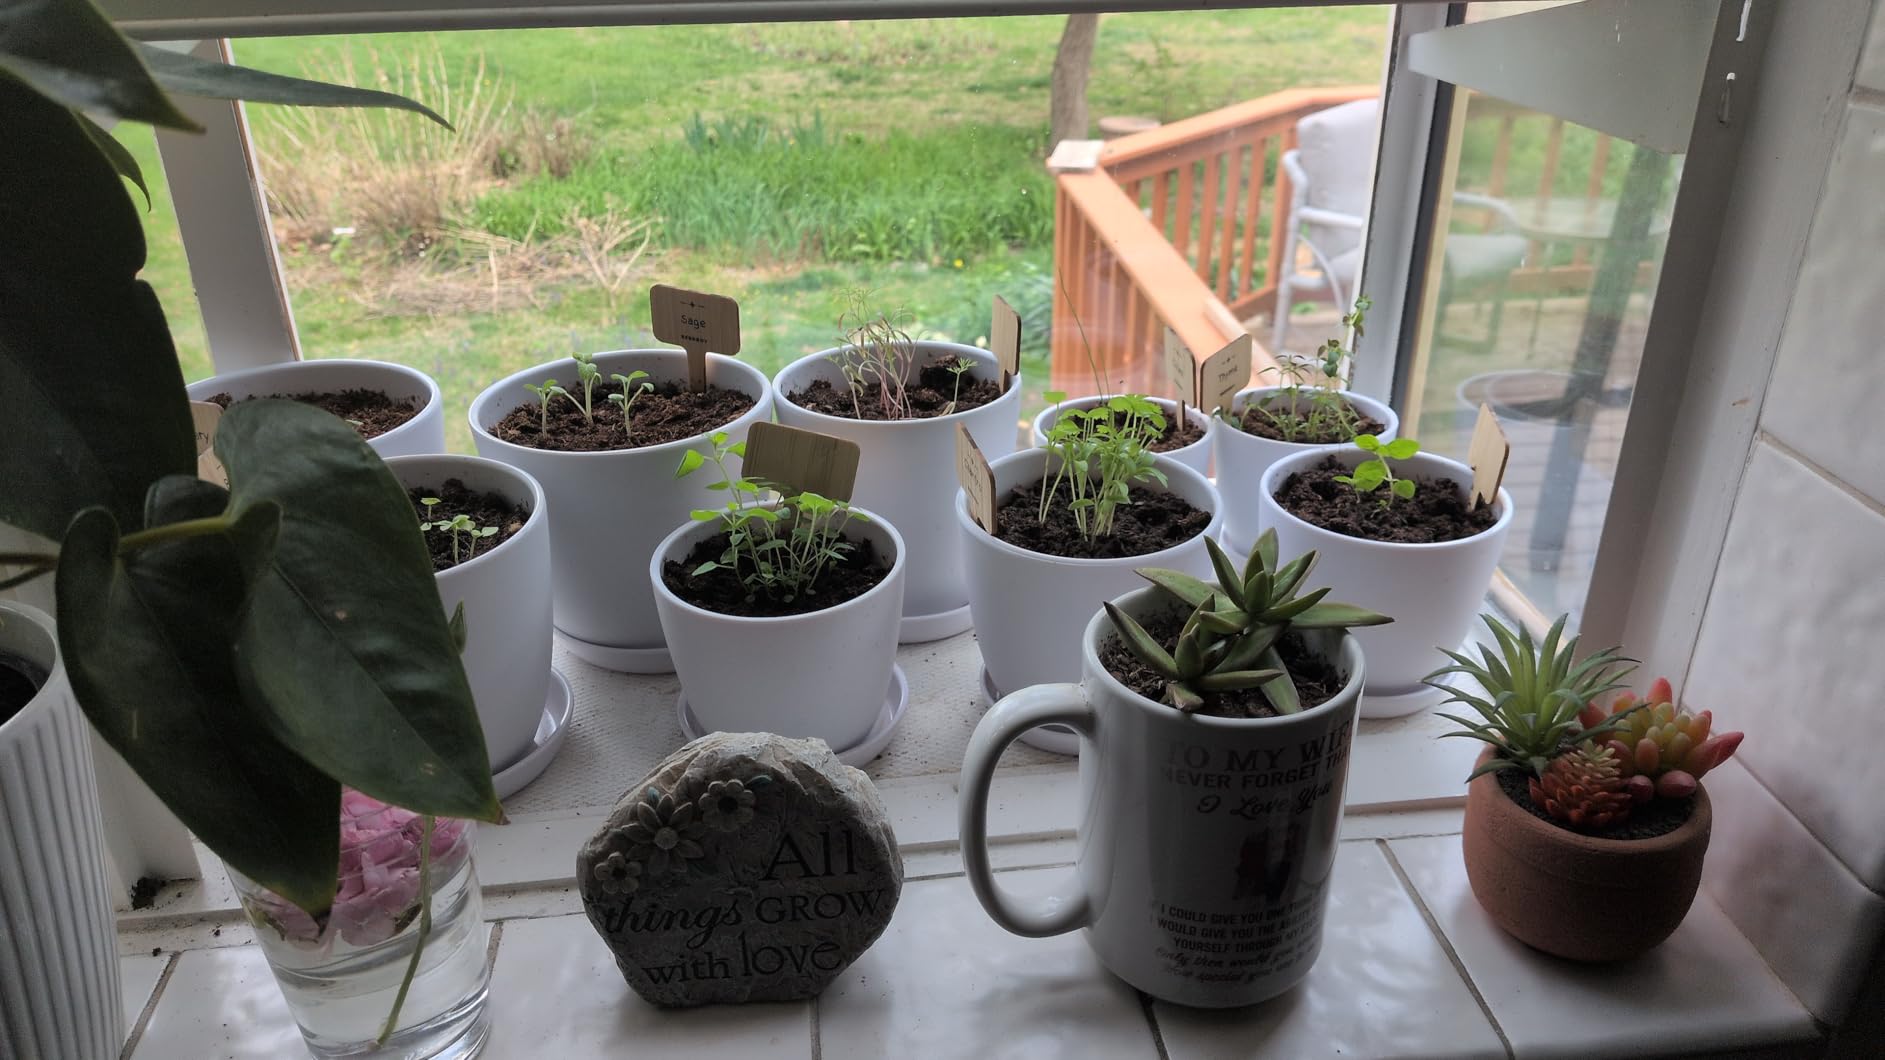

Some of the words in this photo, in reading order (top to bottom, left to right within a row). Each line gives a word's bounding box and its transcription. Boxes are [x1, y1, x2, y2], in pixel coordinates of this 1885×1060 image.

[681, 314, 706, 329] Sage
[1166, 741, 1210, 769] TO
[1224, 746, 1287, 772] MY
[1160, 767, 1231, 789] NEVER
[1242, 764, 1318, 789] FORGET
[1197, 794, 1221, 814] I
[1229, 795, 1289, 821] Love
[1296, 781, 1333, 815] You
[759, 820, 857, 881] All
[602, 896, 741, 948] things
[755, 888, 886, 925] GROW
[1157, 919, 1197, 936] WOULD
[1201, 928, 1227, 939] GIVE
[1232, 927, 1253, 939] YOU
[1168, 906, 1207, 922] COULD
[1211, 913, 1240, 924] GIVE
[1240, 912, 1263, 924] YOU
[1174, 937, 1230, 953] YOURSELF
[1235, 936, 1282, 953] THROUGH
[641, 953, 731, 985] with
[739, 934, 842, 977] love
